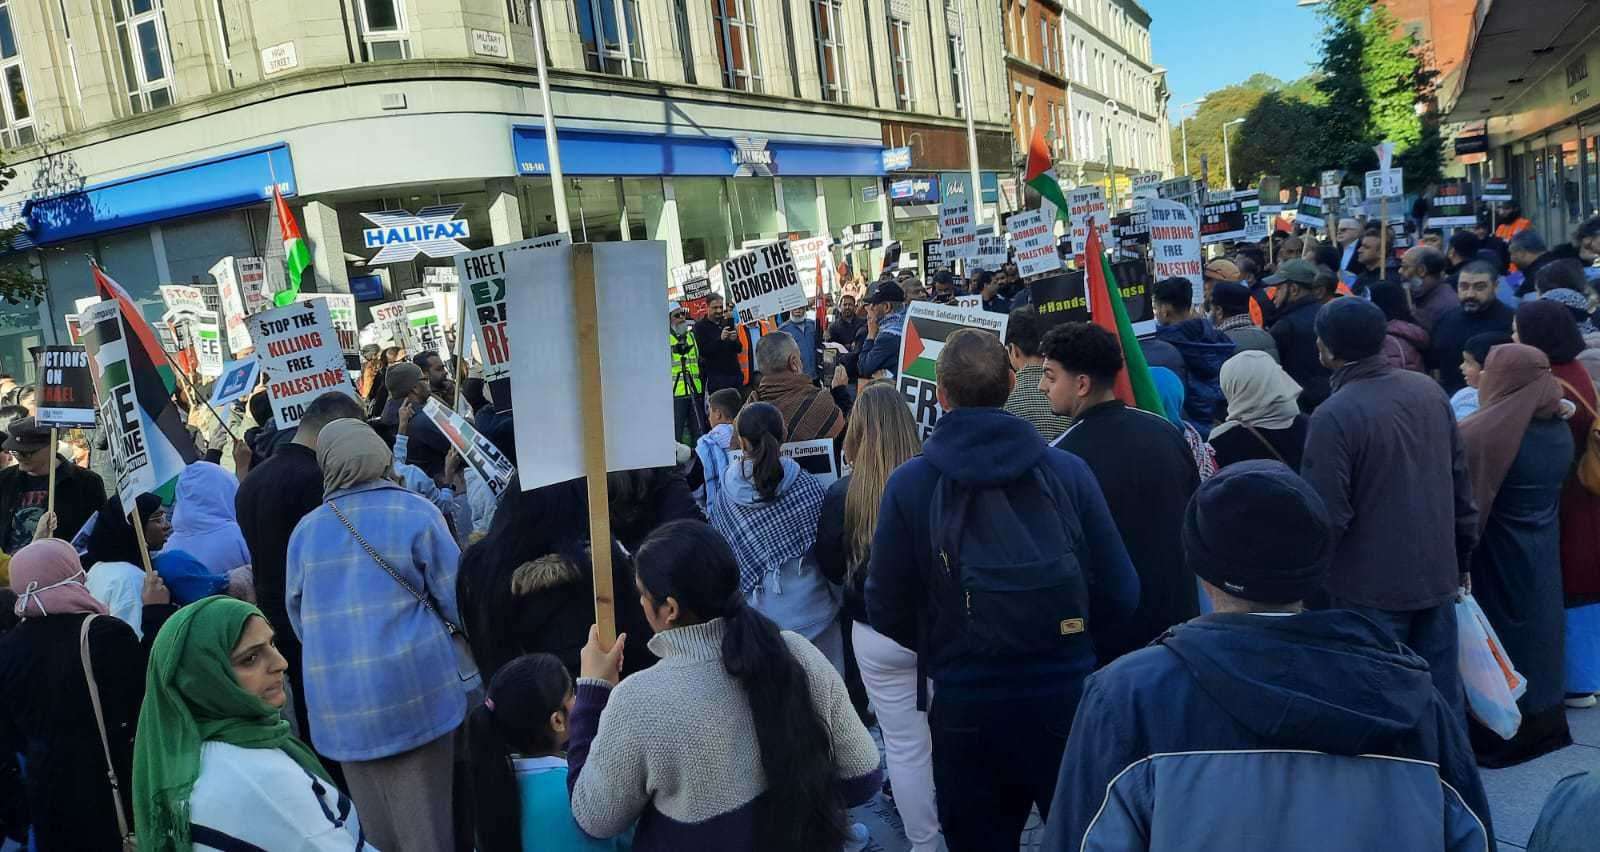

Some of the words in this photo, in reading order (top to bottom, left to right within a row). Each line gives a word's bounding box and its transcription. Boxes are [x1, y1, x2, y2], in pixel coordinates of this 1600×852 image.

[944, 215, 969, 227] KILLING
[366, 221, 466, 247] HALIFAX
[1013, 224, 1048, 241] BOMBING
[1017, 244, 1054, 262] PALESTINE
[1163, 244, 1184, 257] FREE
[464, 252, 499, 280] FREE
[725, 252, 758, 282] STOP
[761, 240, 792, 269] THE
[1156, 260, 1201, 277] PALESTINE
[730, 263, 798, 304] BOMBING
[376, 304, 404, 320] STOP
[935, 310, 966, 322] Solidarity
[967, 314, 1002, 329] Campaign
[260, 318, 290, 337] STOP
[291, 312, 318, 329] THE
[267, 331, 323, 358] KILLING
[286, 355, 316, 373] FREE
[46, 369, 63, 385] ON
[270, 367, 346, 400] PALESTINE
[280, 403, 305, 423] FOA
[794, 445, 829, 457] Campaign
